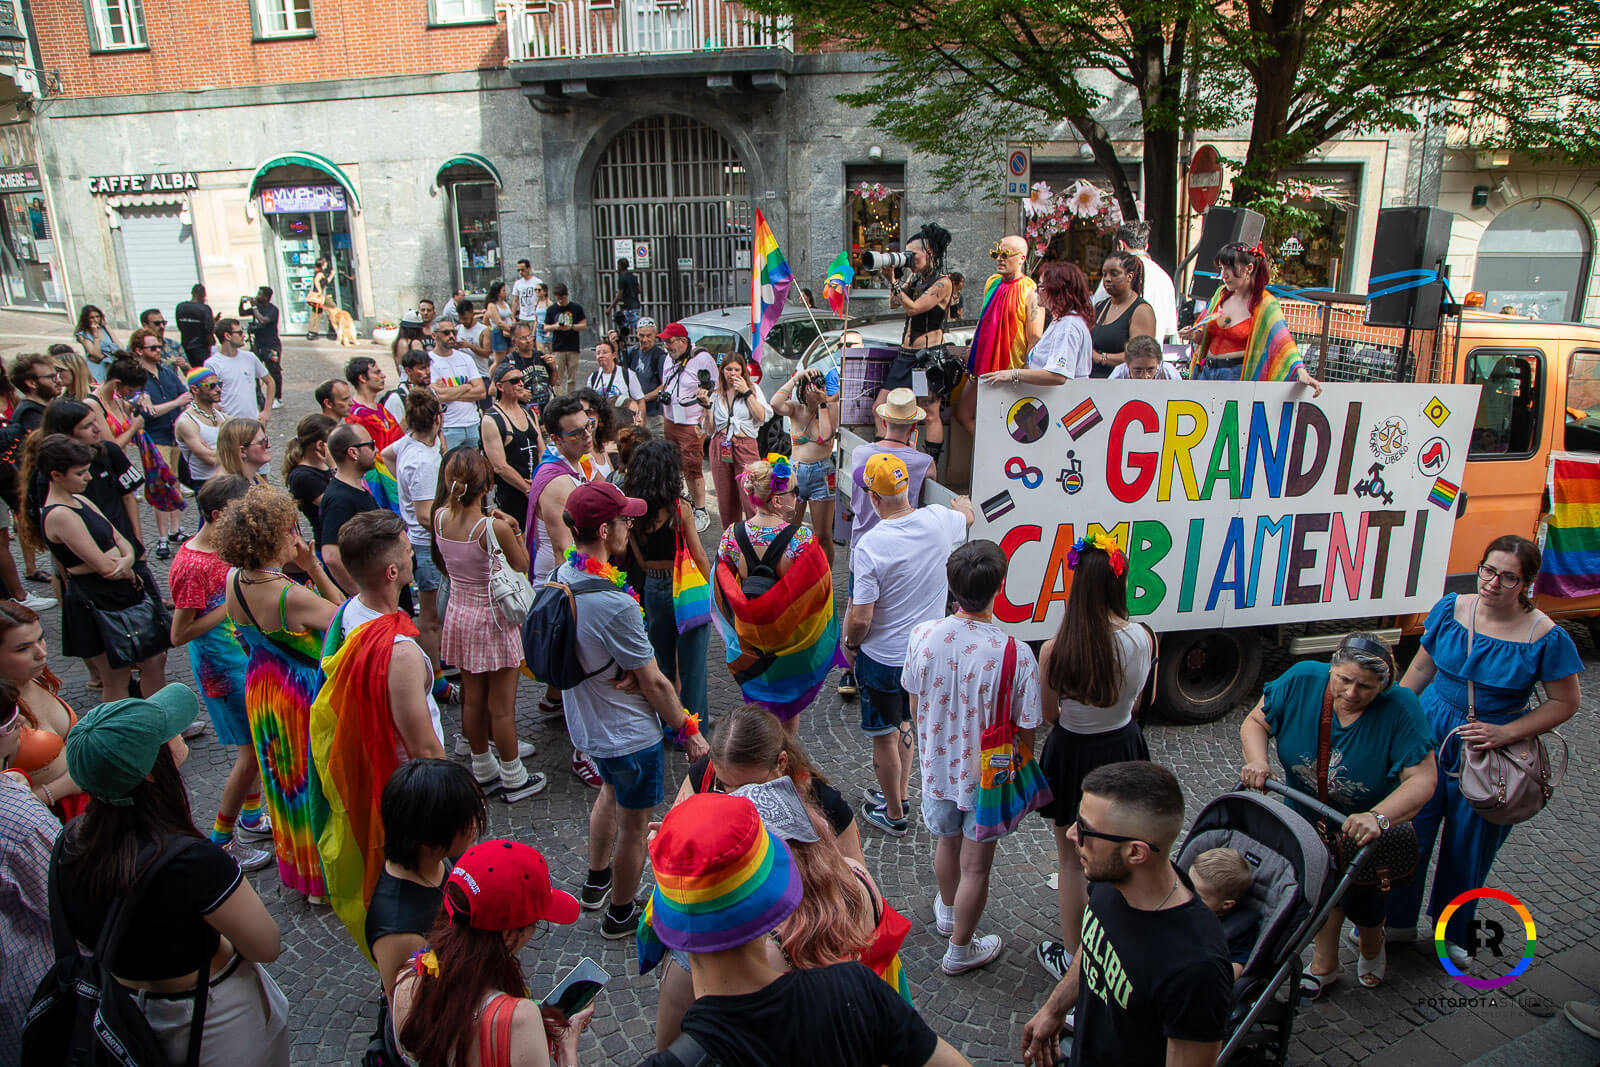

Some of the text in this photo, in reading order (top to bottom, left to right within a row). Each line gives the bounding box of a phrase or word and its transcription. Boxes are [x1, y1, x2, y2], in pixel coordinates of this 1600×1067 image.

[88, 172, 196, 193] CAFFE' ALBA
[274, 186, 344, 201] VIVIPHONE
[1106, 400, 1362, 503] GRANDI
[1368, 424, 1409, 465] ABORTO LIBERO
